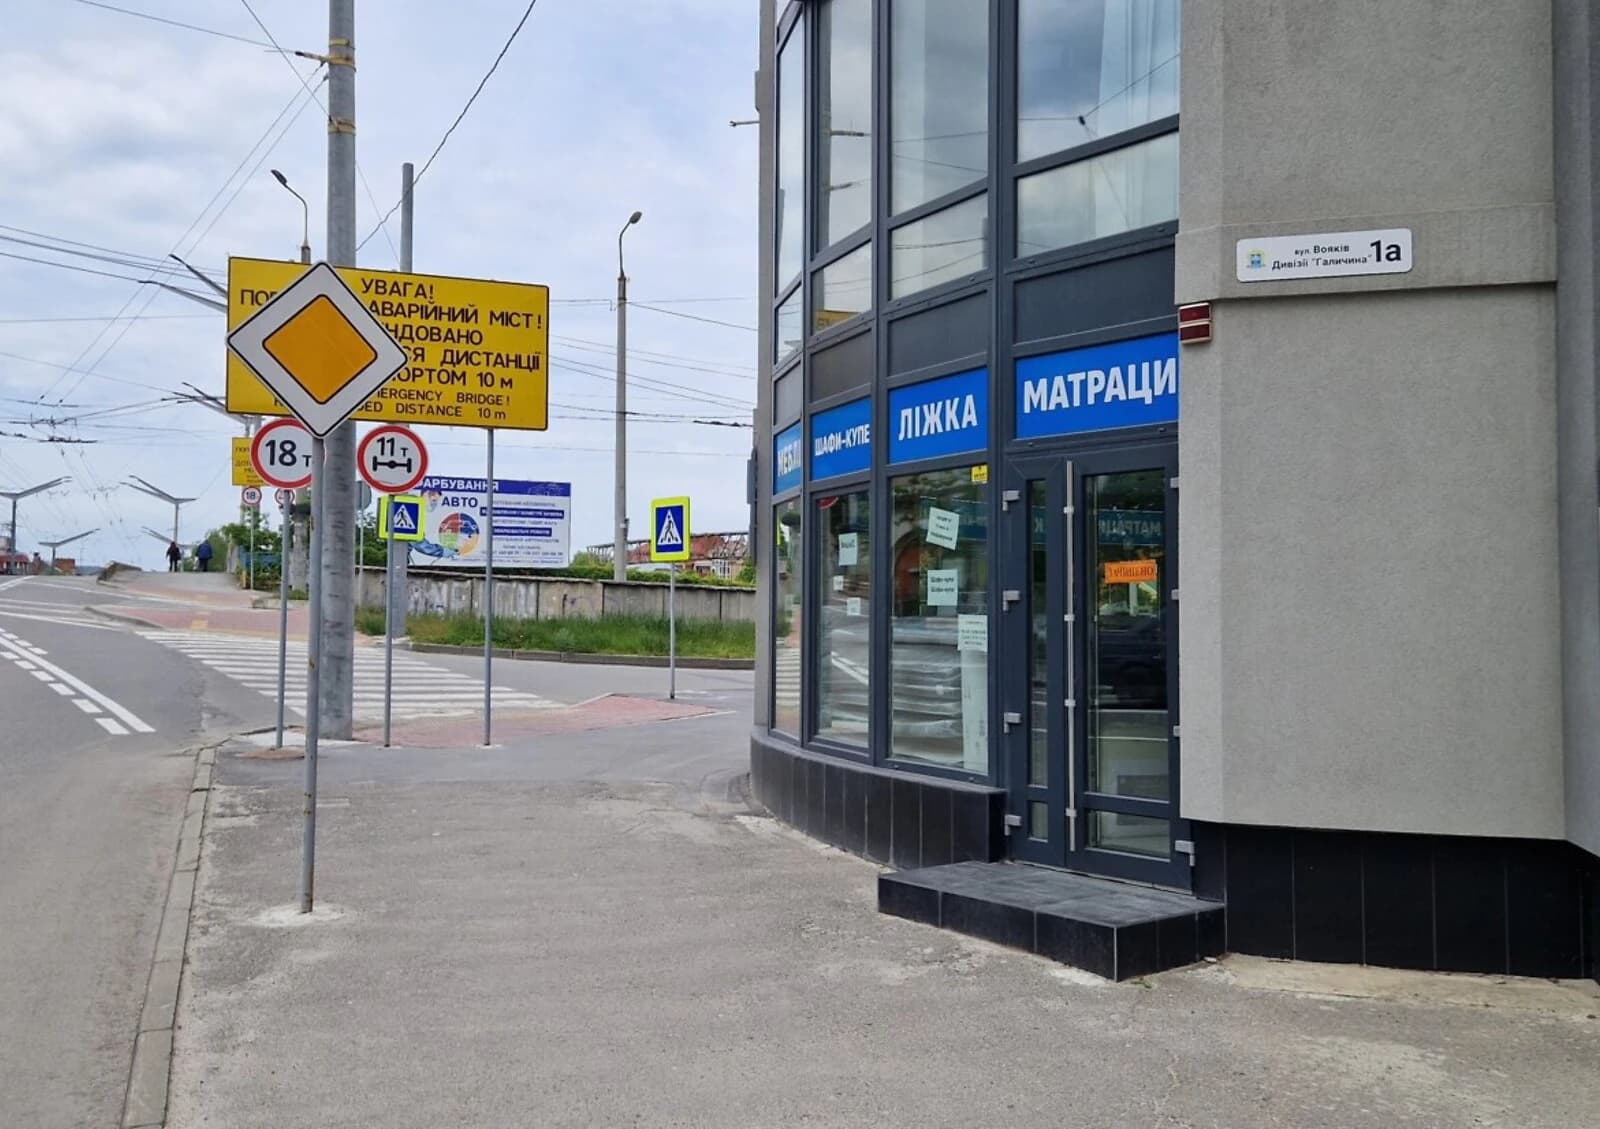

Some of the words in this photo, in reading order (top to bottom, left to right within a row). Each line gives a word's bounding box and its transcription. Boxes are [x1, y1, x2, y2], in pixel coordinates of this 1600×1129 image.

[1313, 244, 1350, 254] Вояків
[1369, 239, 1402, 263] 1а
[1271, 259, 1309, 270] Дивізії
[361, 277, 434, 299] УВАГА!
[369, 300, 479, 324] АВАРІЙНИЙ
[382, 322, 483, 345] НДОВАНО
[440, 349, 541, 373] ДИСТАНЦІЇ
[393, 366, 467, 386] ОРТОМ
[477, 371, 495, 387] 10
[500, 377, 513, 389] м
[1023, 357, 1177, 414] МАТРАЦИ
[396, 402, 463, 417] DISTANCE
[478, 408, 491, 419] 10
[494, 410, 506, 419] m
[898, 394, 978, 441] ЛІЖКА
[377, 437, 395, 457] 11
[400, 447, 409, 457] т
[814, 423, 870, 457] ШАФИ-КУПЕ
[265, 439, 297, 467] 18
[441, 496, 479, 508] АВТО
